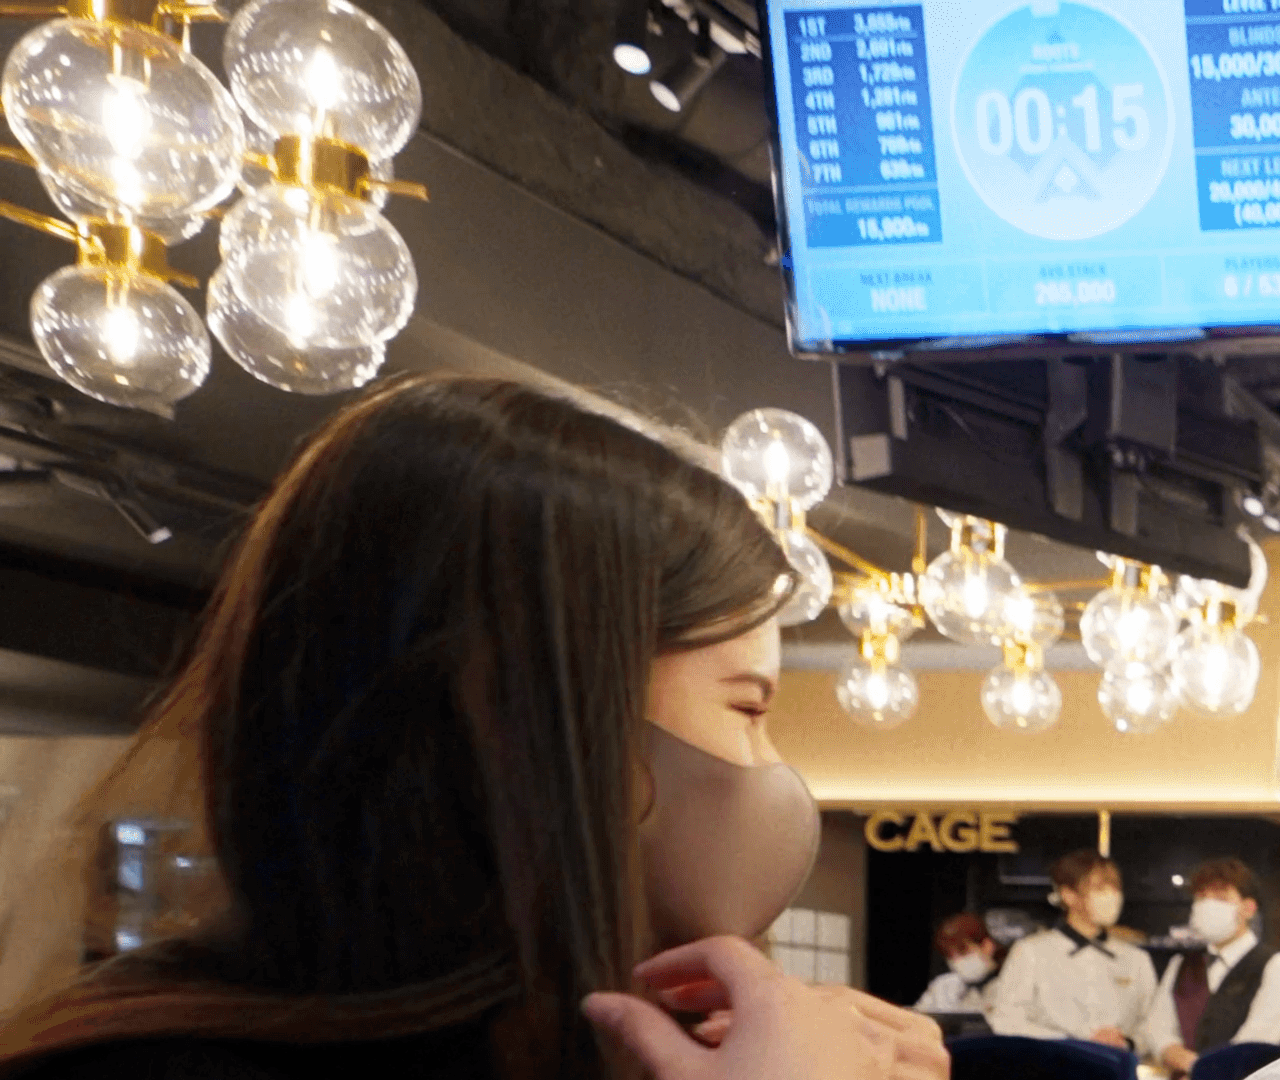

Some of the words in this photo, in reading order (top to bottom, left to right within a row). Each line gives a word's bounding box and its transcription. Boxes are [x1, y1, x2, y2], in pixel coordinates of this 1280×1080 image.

[799, 16, 826, 37] 1ST
[801, 42, 832, 62] 2ND
[803, 65, 835, 87] 3RD
[805, 90, 836, 110] 4TH
[1241, 86, 1280, 107] ANTE
[976, 82, 1150, 156] 00:15
[1221, 158, 1260, 177] NEXT
[870, 287, 927, 313] NONE
[864, 810, 1019, 853] CAGE
